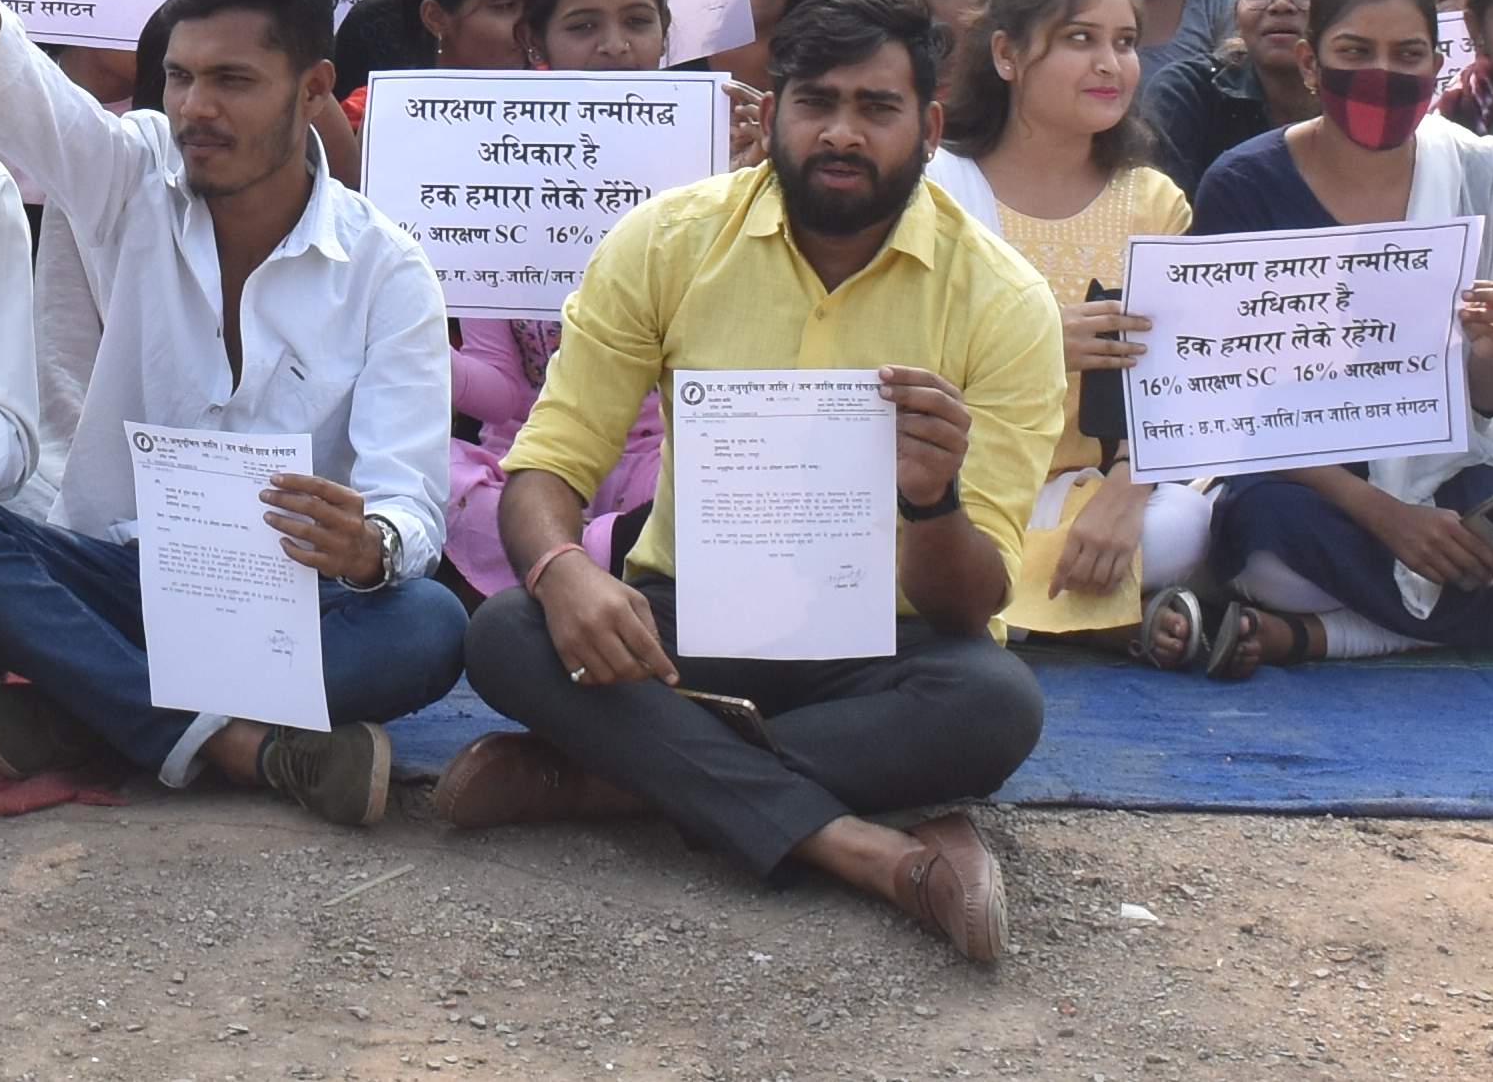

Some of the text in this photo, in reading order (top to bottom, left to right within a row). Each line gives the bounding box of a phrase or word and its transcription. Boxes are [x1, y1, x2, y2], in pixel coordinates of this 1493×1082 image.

[405, 93, 678, 126] आरक्षण हमारा जन्मसिद्ध
[478, 134, 601, 170] अधिकार है
[421, 184, 460, 210] हक
[465, 184, 534, 213] हमारा
[541, 178, 587, 210] लेके
[1166, 243, 1433, 288] आरक्षण हमारा जन्मसिद्ध
[1237, 283, 1354, 318] अधिकार है
[1175, 335, 1216, 361] हक
[1220, 330, 1285, 359] हमारा
[1291, 324, 1336, 352] लेके
